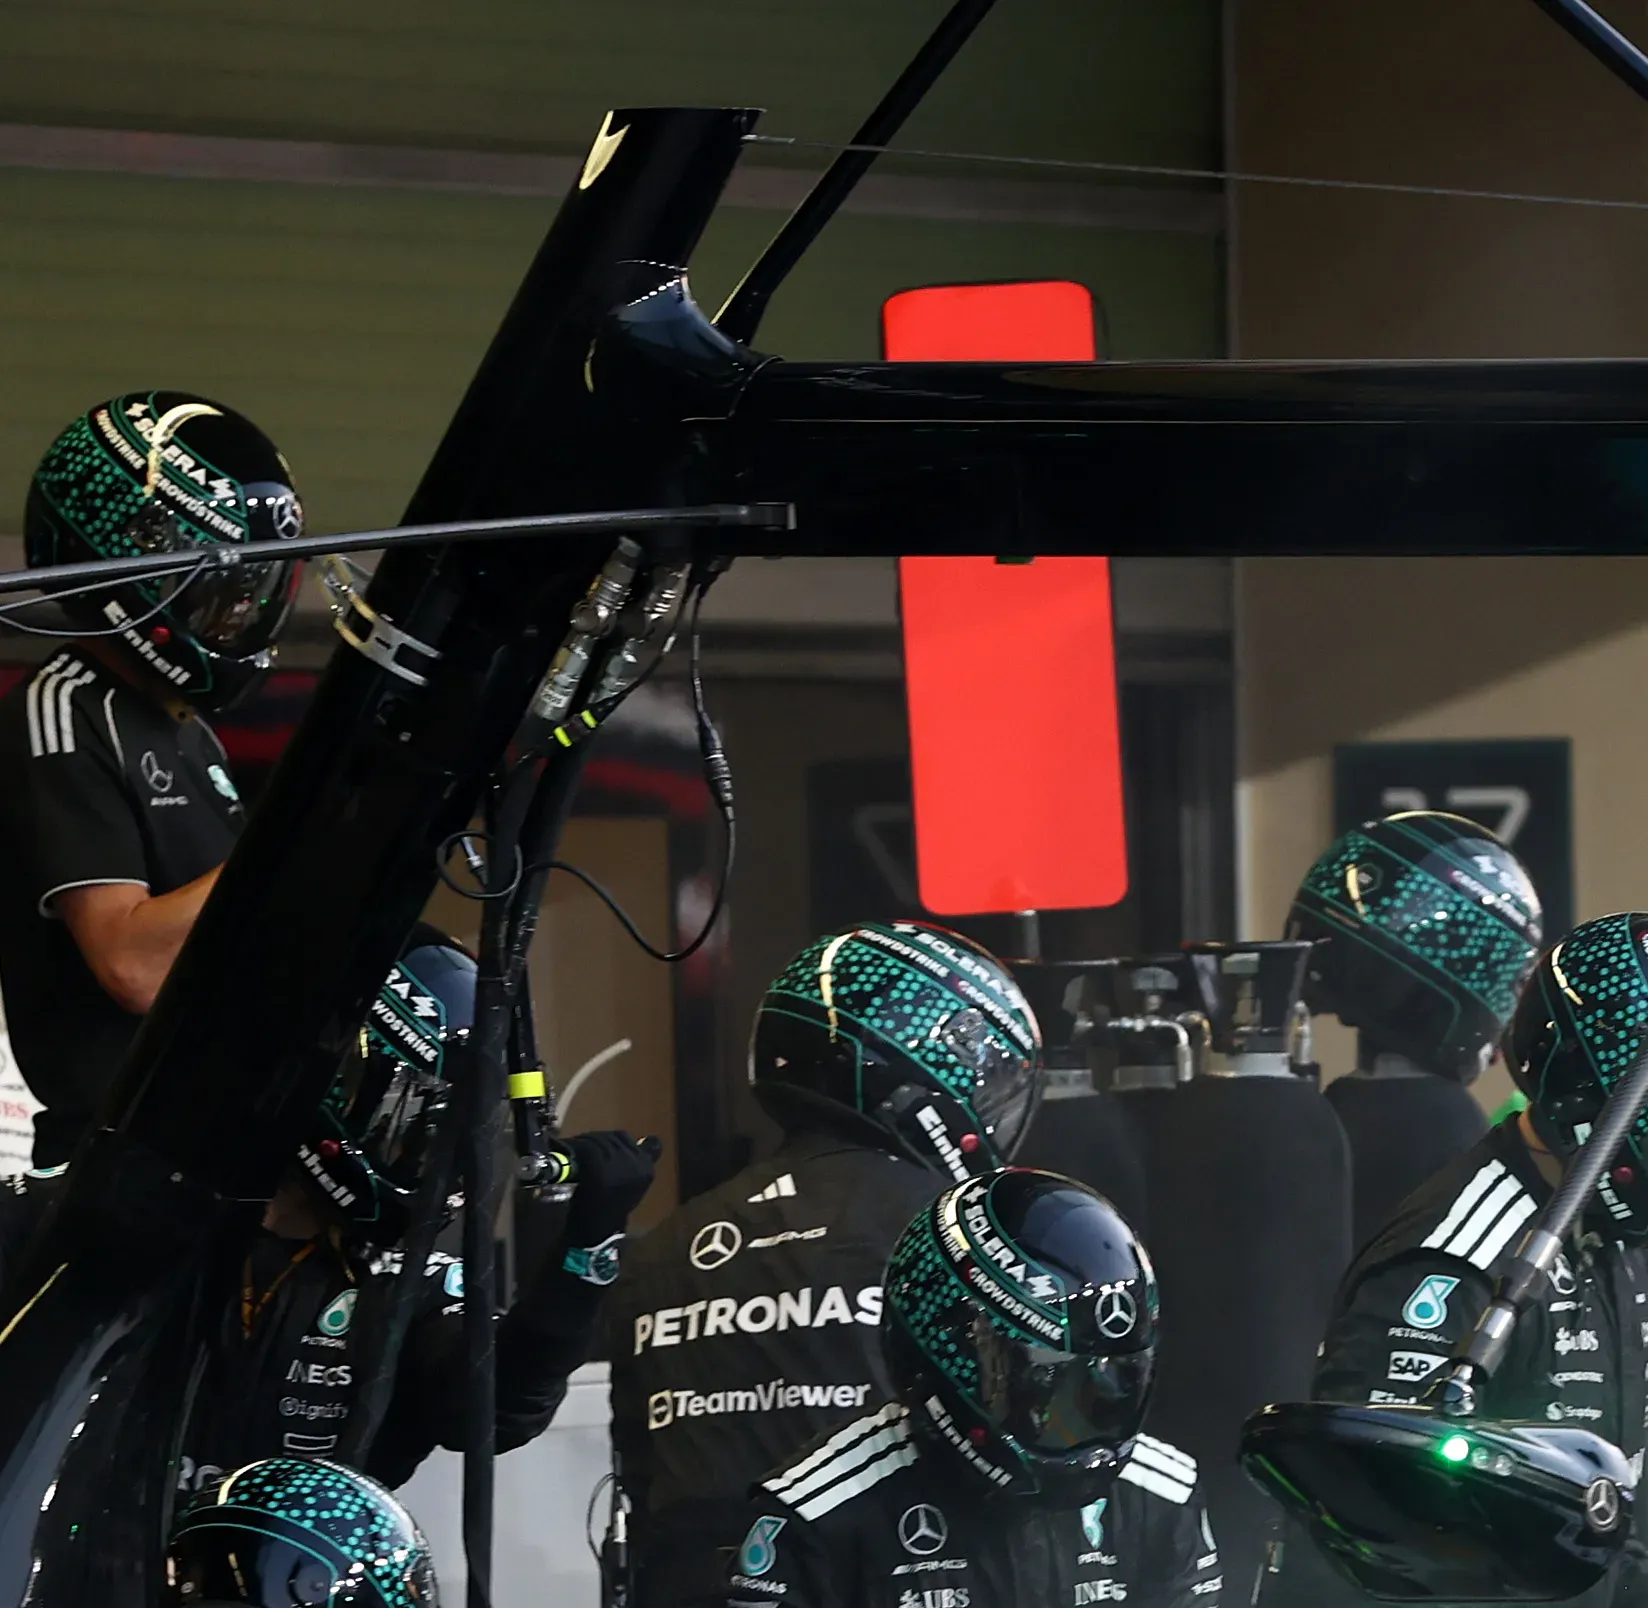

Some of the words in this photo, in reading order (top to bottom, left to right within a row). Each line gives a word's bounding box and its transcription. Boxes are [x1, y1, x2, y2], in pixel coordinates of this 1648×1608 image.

[914, 932, 1005, 995] SOLERA
[964, 1203, 1028, 1283] SOLERA
[633, 1286, 884, 1355] PETRONAS
[968, 1265, 1066, 1341] CROWDSTRIKE
[673, 1377, 872, 1418] TeamViewer
[1391, 1356, 1431, 1376] SAP
[925, 1395, 1013, 1487] Einhell
